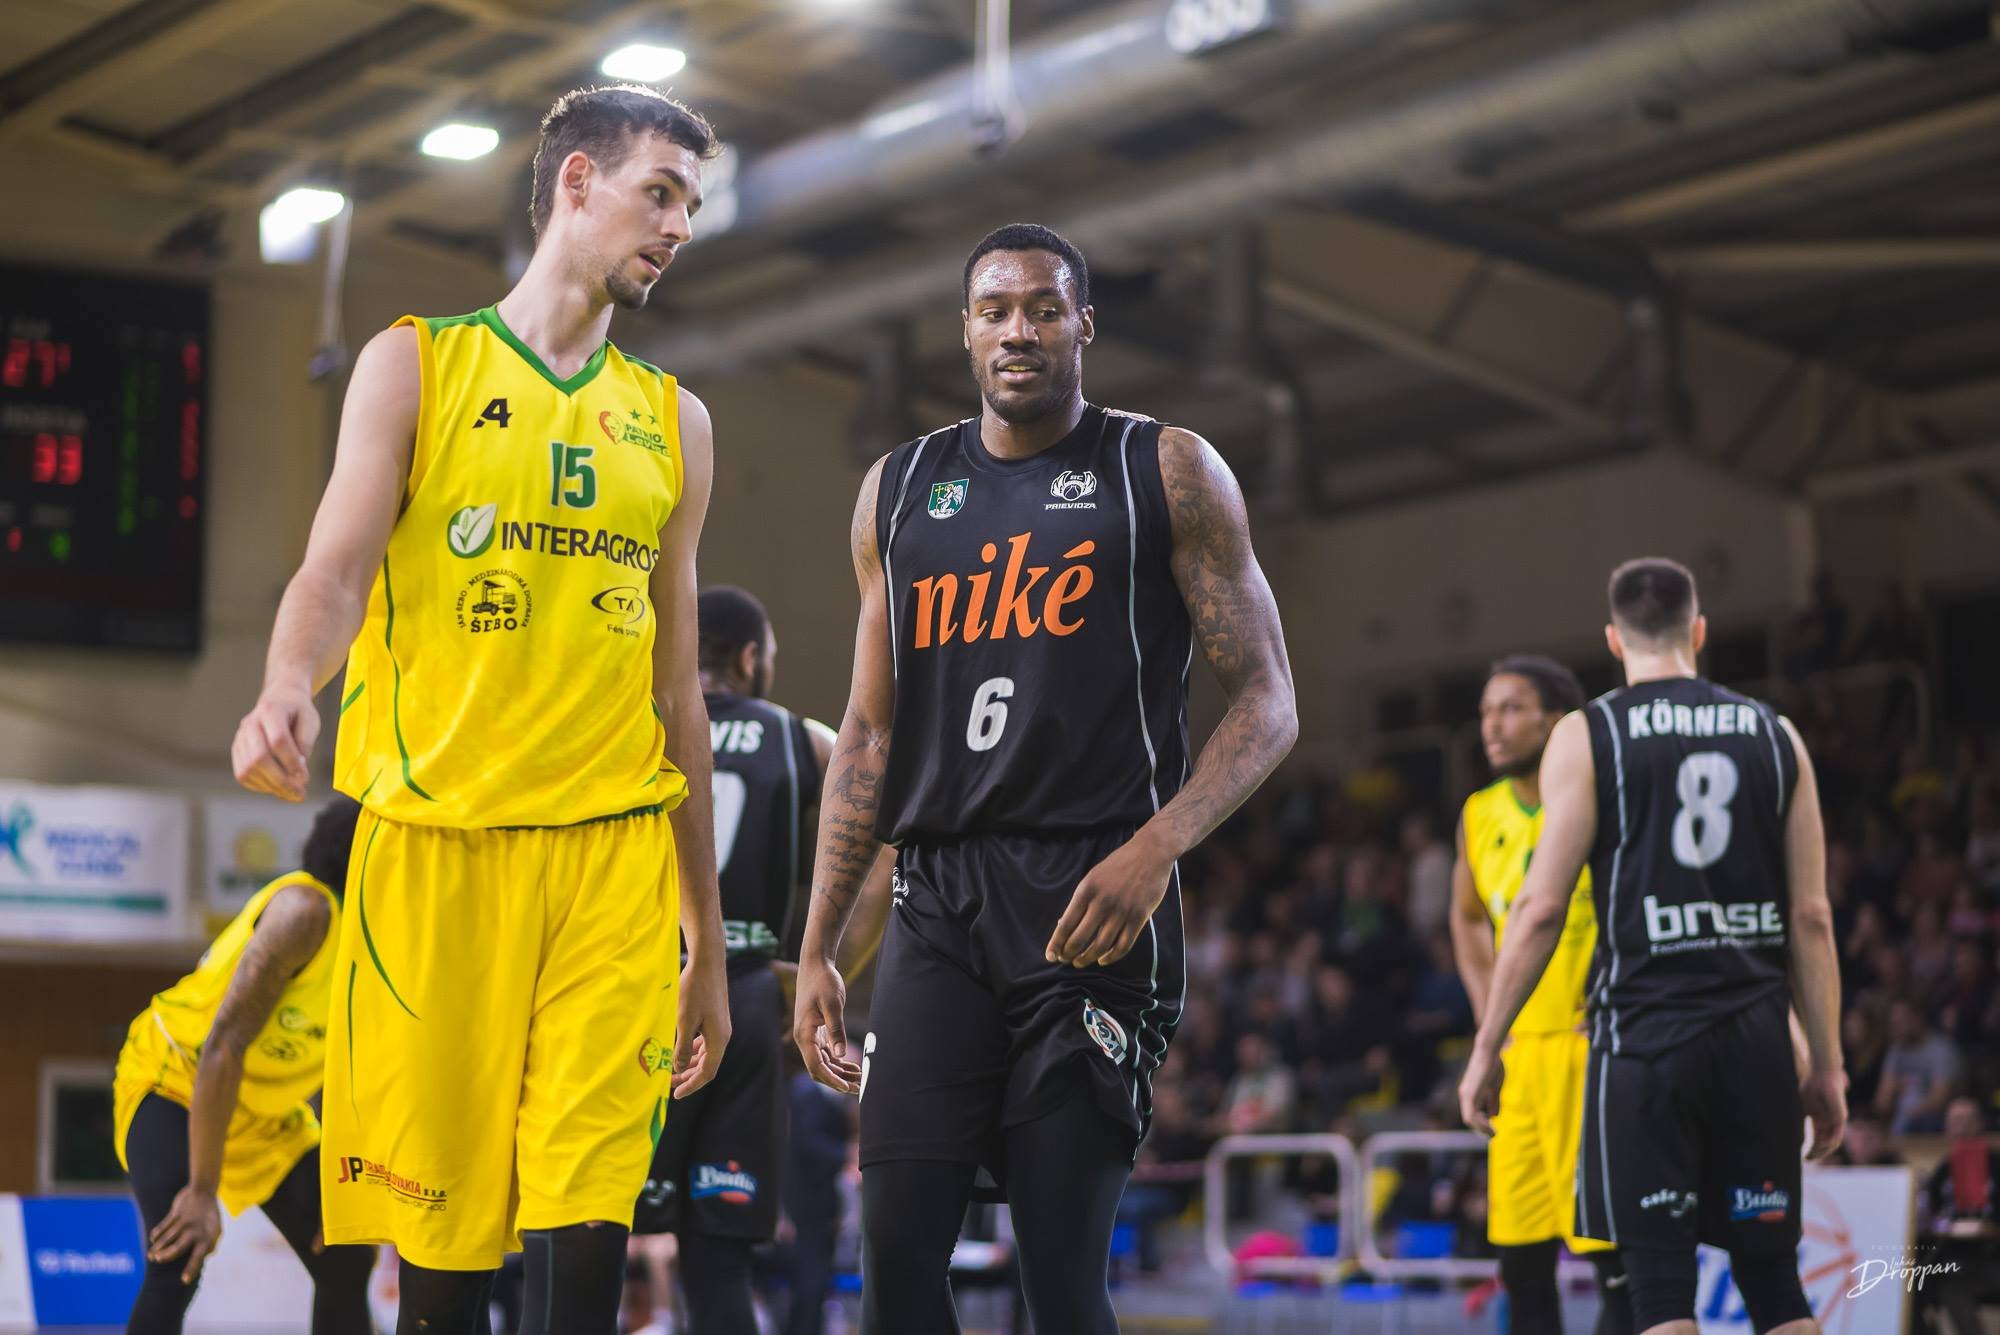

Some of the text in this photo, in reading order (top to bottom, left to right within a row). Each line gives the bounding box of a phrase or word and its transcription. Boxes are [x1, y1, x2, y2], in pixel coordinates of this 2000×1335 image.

[550, 440, 597, 510] 15
[1044, 502, 1098, 511] PRIEVIDZA
[912, 531, 1096, 649] niké
[470, 616, 518, 633] ŠEBO
[966, 676, 1015, 752] 6
[1627, 698, 1758, 740] KÖRNER
[709, 719, 765, 754] VIS
[1671, 750, 1739, 869] 8
[338, 1156, 364, 1184] JP
